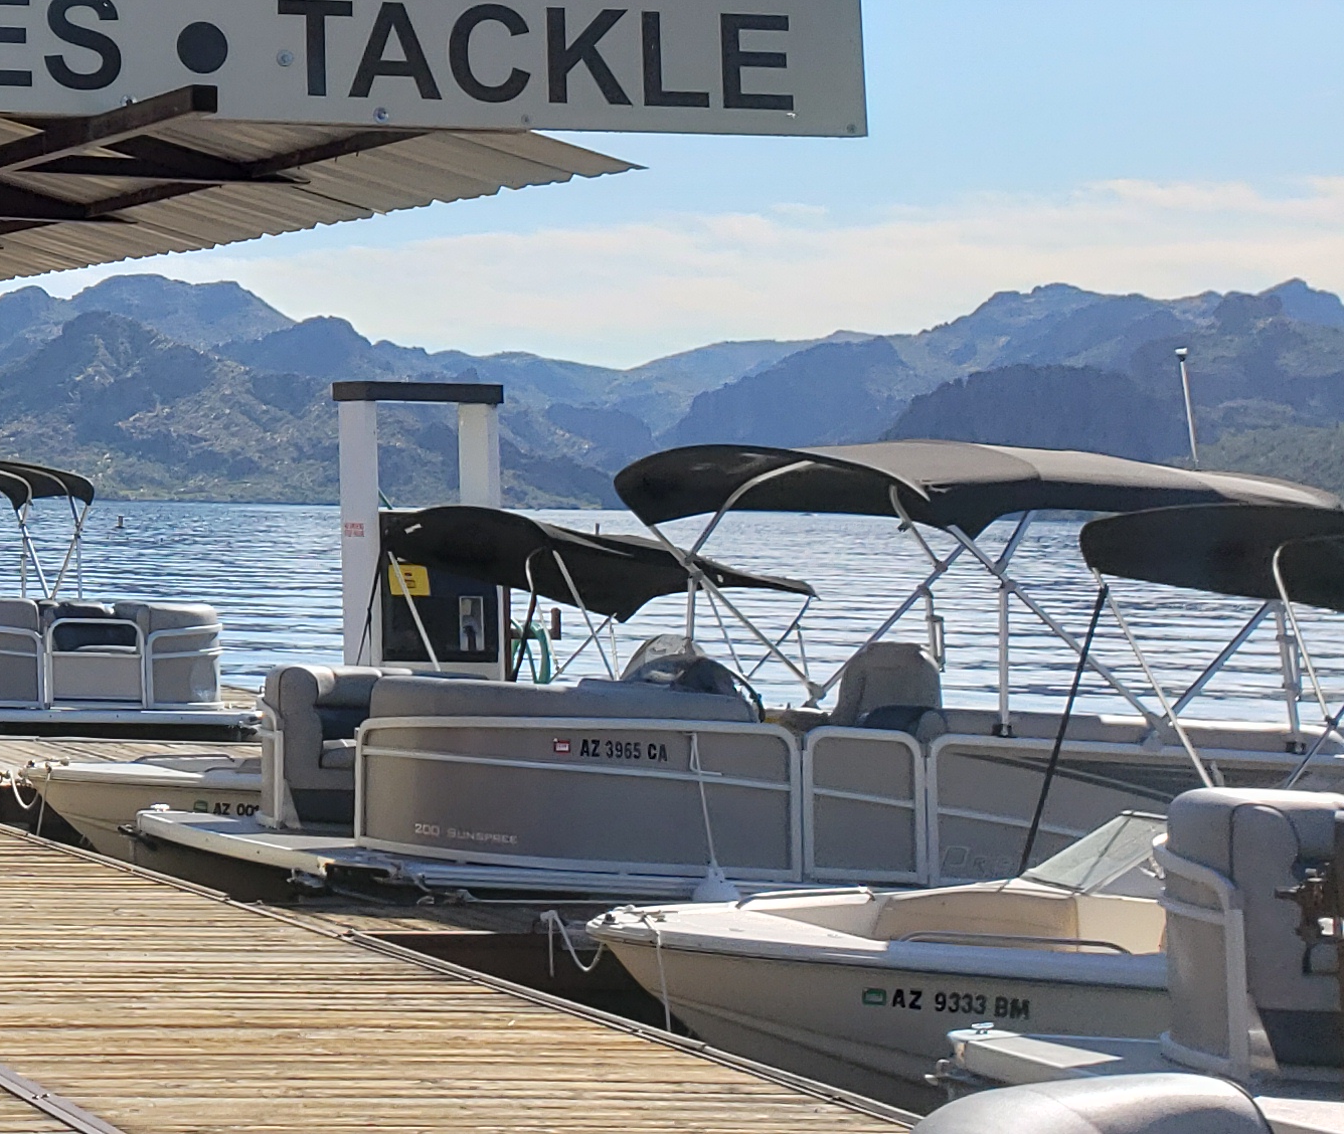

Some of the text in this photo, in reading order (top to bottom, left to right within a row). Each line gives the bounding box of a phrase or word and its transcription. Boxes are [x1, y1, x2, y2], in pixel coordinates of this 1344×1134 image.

[579, 738, 668, 762] AZ 3965 CA
[212, 802, 231, 816] AZ
[414, 823, 441, 837] 200
[892, 988, 1031, 1021] AZ 9333 BM
